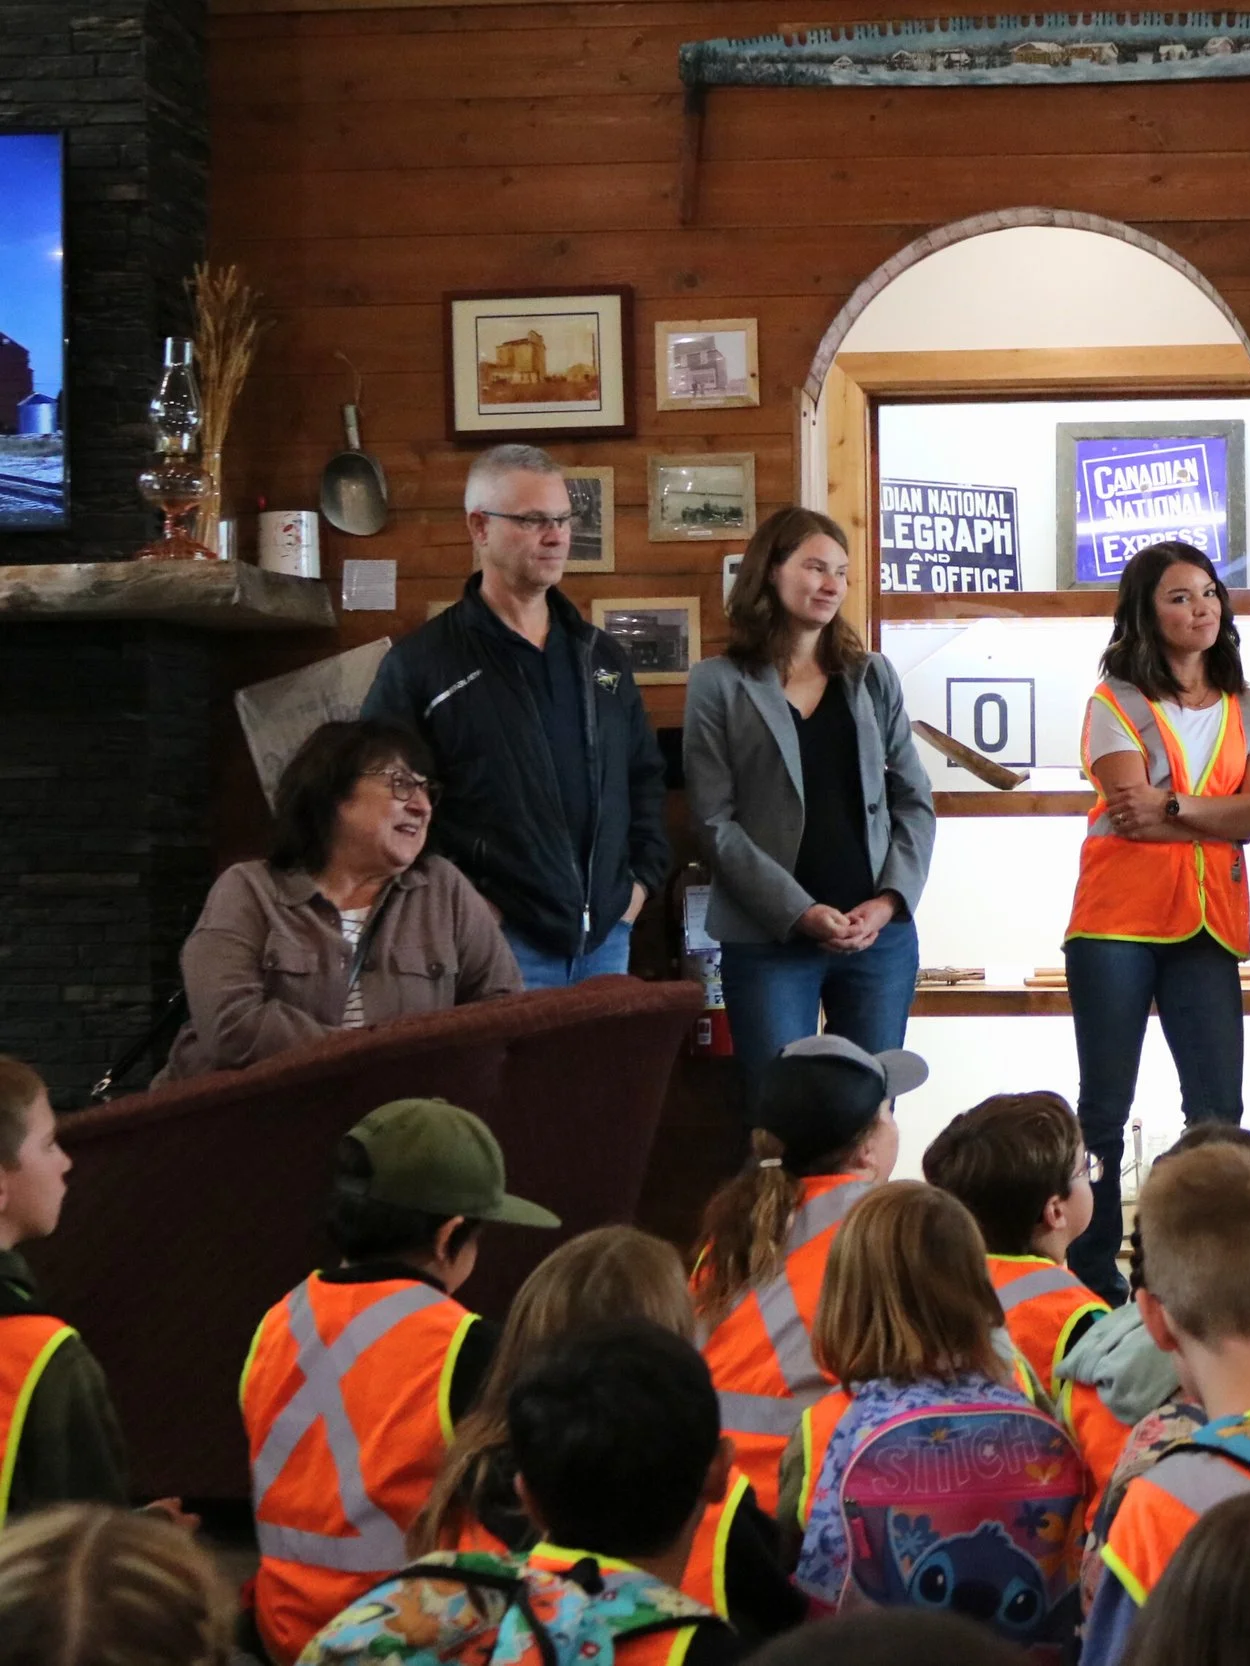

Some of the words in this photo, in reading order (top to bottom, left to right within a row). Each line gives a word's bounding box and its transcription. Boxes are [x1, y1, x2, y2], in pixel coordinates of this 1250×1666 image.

[1093, 457, 1200, 500] CANADIAN
[927, 488, 1011, 519] NATIONAL
[1104, 491, 1204, 521] NATIONAL
[908, 552, 951, 564] AND
[931, 565, 1014, 593] OFFICE
[871, 1413, 1040, 1496] STITCH
